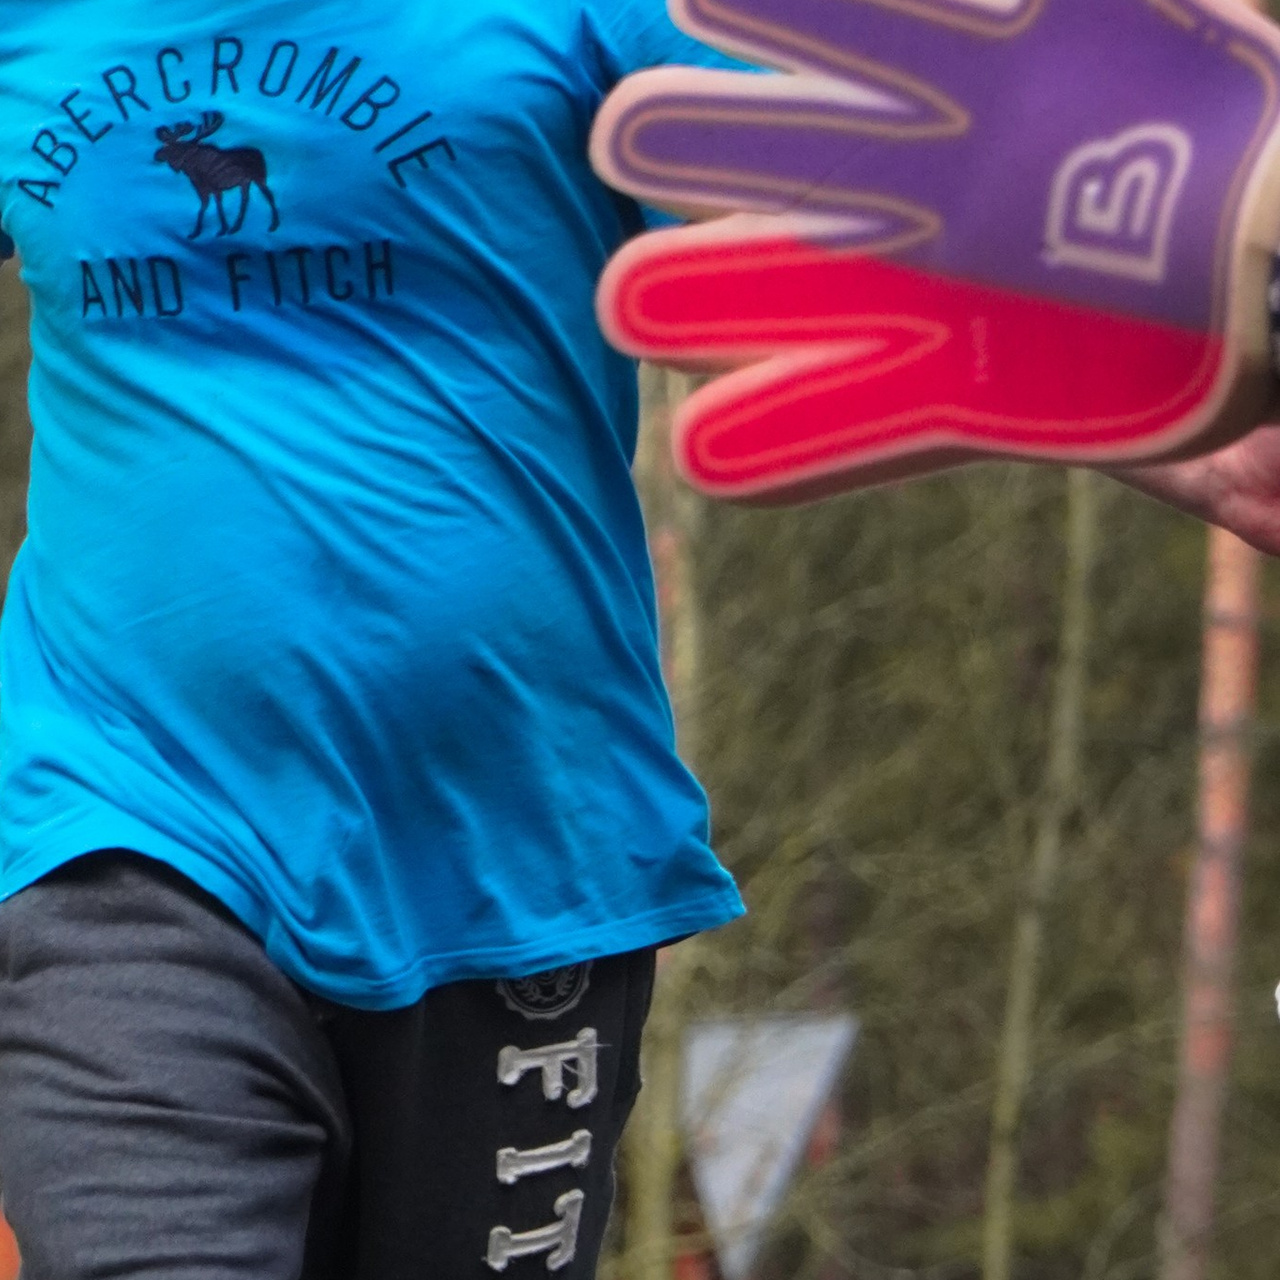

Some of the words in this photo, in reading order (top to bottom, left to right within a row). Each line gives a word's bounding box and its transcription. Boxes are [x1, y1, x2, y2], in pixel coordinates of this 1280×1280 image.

[17, 35, 457, 209] ABERCROMBIE
[80, 254, 185, 319] AND
[226, 238, 395, 313] FITCH
